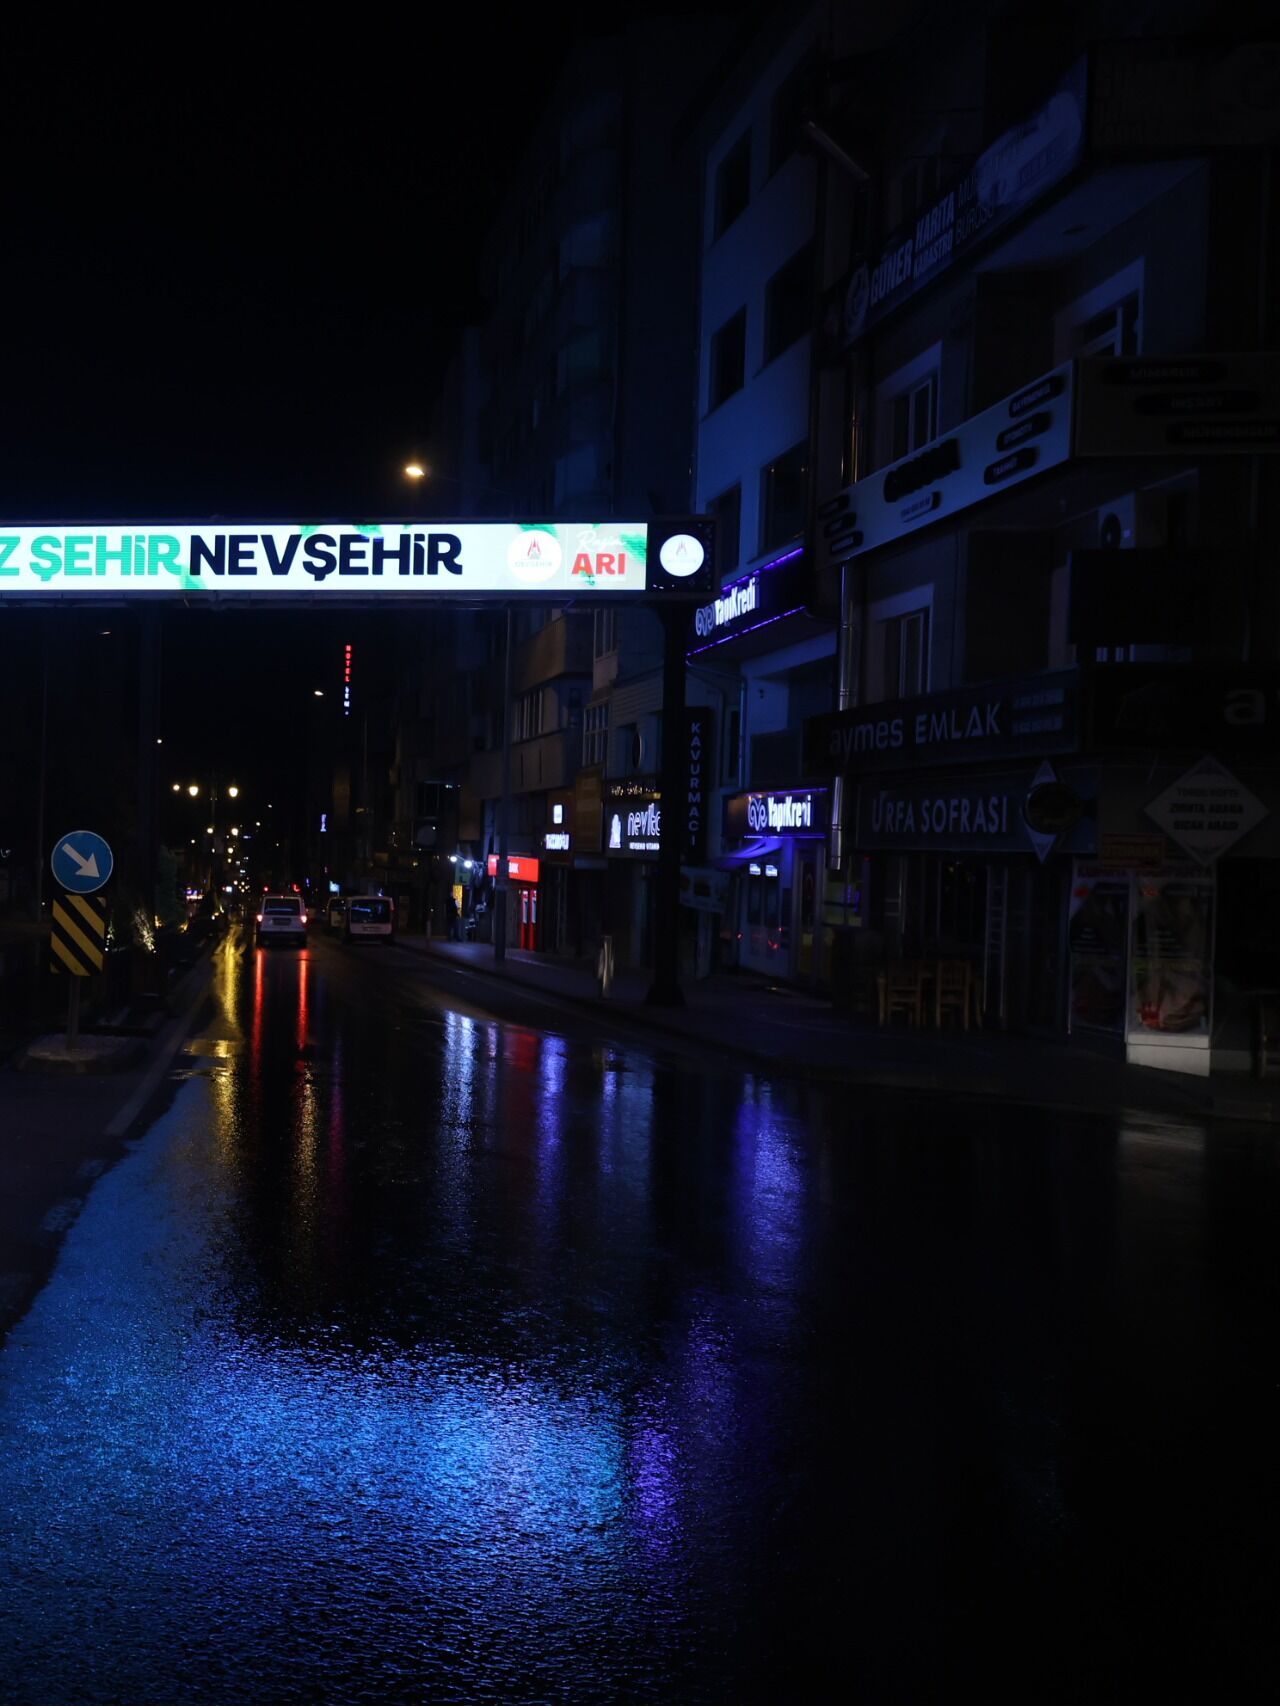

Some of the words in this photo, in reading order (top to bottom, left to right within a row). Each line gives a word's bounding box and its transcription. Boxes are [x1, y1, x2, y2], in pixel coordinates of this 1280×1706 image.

[571, 552, 628, 576] ARI
[829, 718, 905, 767] aymes
[914, 702, 1002, 745] EMLAK
[687, 720, 702, 848] KAVURMACI
[920, 795, 1008, 833] SOFRASI
